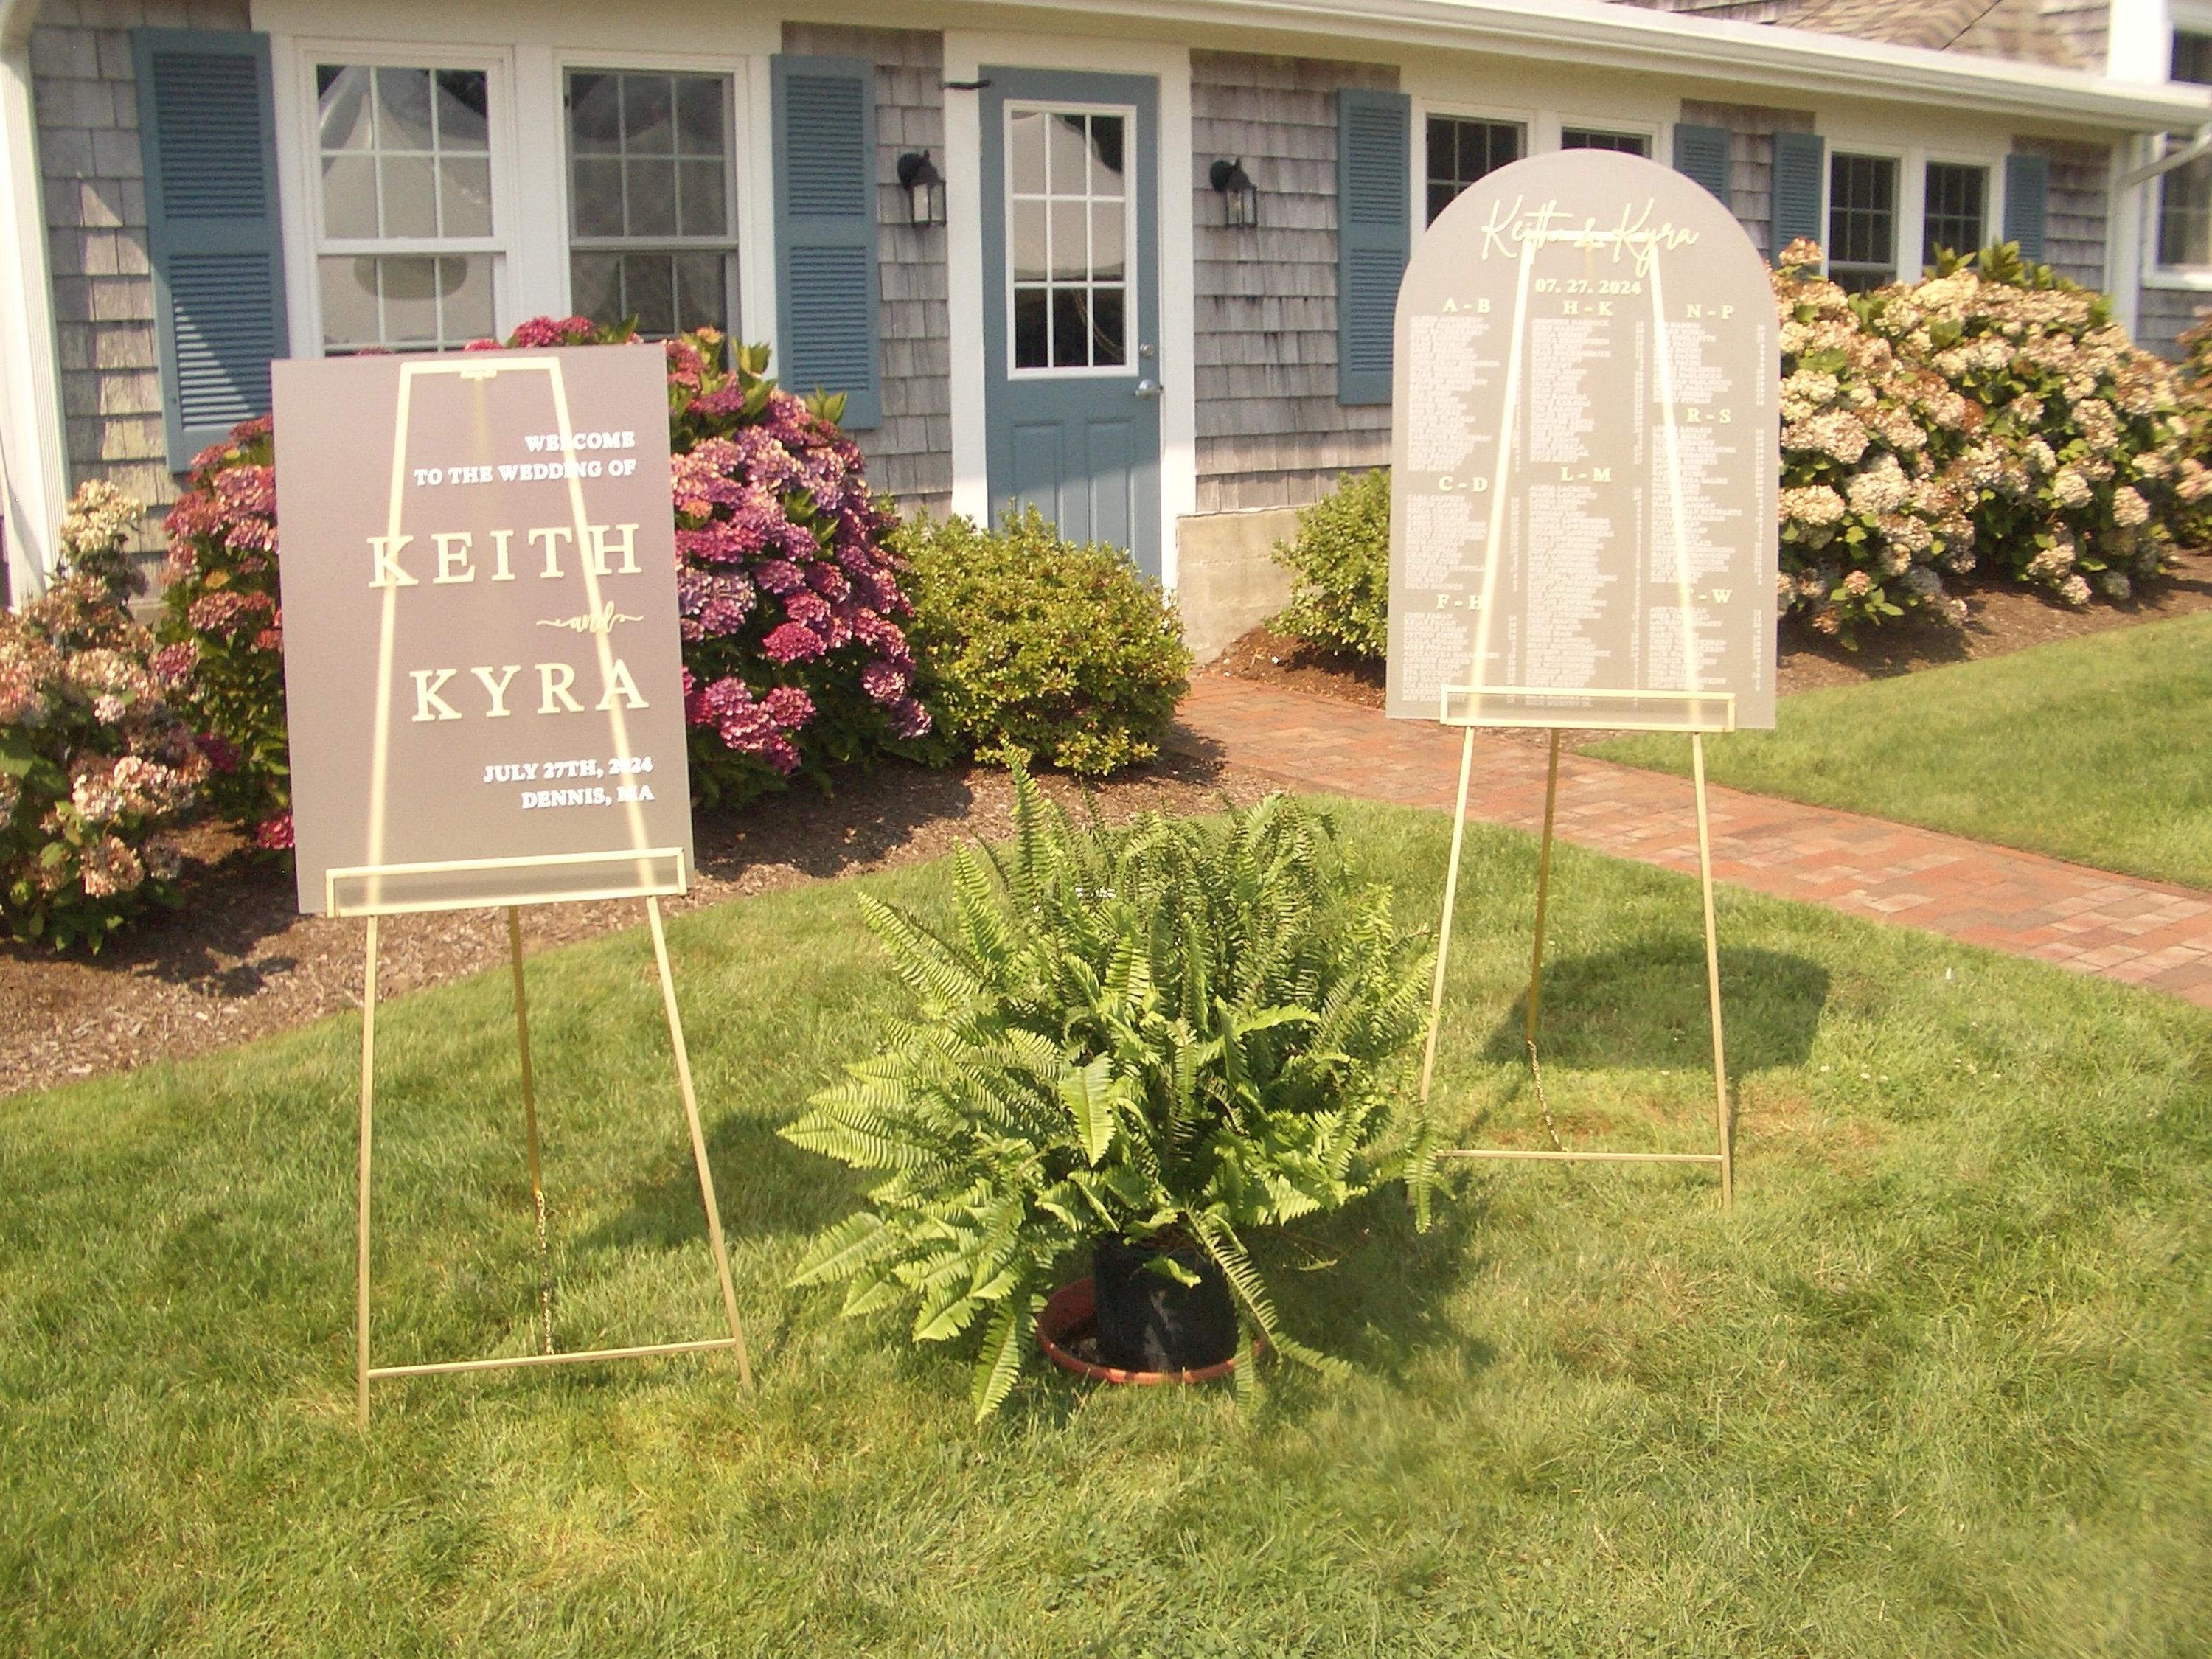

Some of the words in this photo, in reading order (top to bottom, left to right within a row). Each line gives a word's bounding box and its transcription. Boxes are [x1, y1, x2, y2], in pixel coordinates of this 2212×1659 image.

[1611, 198, 1699, 279] Kyra
[1535, 279, 1562, 293] 07.
[1567, 280, 1593, 294] 27.
[1599, 280, 1642, 295] 2024
[1443, 297, 1458, 313] A
[1478, 298, 1491, 314] B
[1562, 301, 1580, 316] H
[1599, 301, 1614, 317] K
[1686, 304, 1702, 319] N
[1722, 305, 1734, 320] P
[1686, 408, 1701, 423] R
[1719, 408, 1731, 424] S
[524, 431, 636, 453] WELCOME
[413, 468, 443, 486] TO
[448, 465, 493, 484] THE
[498, 460, 602, 481] WEDDING
[608, 459, 637, 476] OF
[1561, 467, 1574, 482] L
[1593, 467, 1612, 483] M
[1439, 476, 1453, 492] C
[1472, 476, 1488, 492] D
[366, 523, 642, 588] KEITH
[1436, 594, 1450, 610] F
[1711, 588, 1733, 603] W
[536, 601, 645, 633] and
[409, 658, 650, 723] KYRA
[483, 762, 539, 783] JULY
[543, 759, 605, 779] 27TH,
[521, 787, 612, 809] DENNIS,
[616, 785, 655, 803] MA
